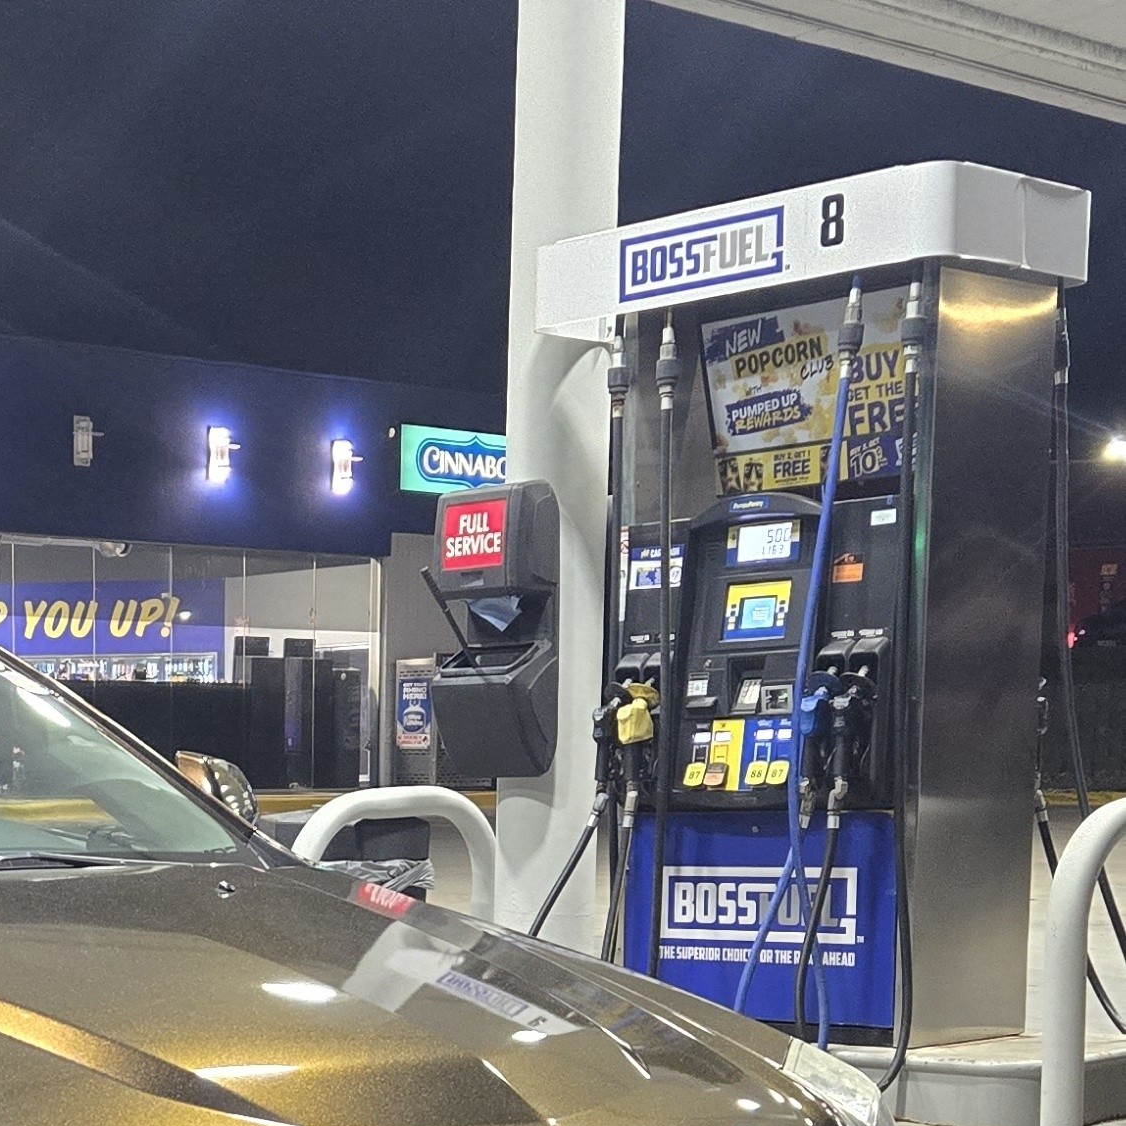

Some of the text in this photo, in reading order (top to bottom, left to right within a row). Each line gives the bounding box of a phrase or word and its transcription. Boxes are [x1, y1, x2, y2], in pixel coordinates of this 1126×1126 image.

[820, 193, 845, 248] 8
[725, 319, 763, 357] NEW
[734, 336, 823, 378] POPCORN
[800, 354, 834, 380] CLUB
[851, 349, 900, 384] BUY
[875, 381, 903, 398] THE
[731, 392, 798, 422] PUMPED UP
[735, 405, 802, 433] REWARDS
[848, 397, 906, 436] FRE
[774, 458, 811, 478] FREE
[458, 511, 490, 535] FULL
[445, 531, 502, 558] SERVICE
[24, 599, 98, 640] YOU
[109, 596, 180, 638] UP!
[659, 945, 675, 960] THE
[676, 946, 721, 962] SUPERIOR
[722, 948, 752, 962] CHOIC
[759, 949, 774, 964] OR
[775, 950, 793, 964] THE
[822, 952, 856, 967] AHEAD
